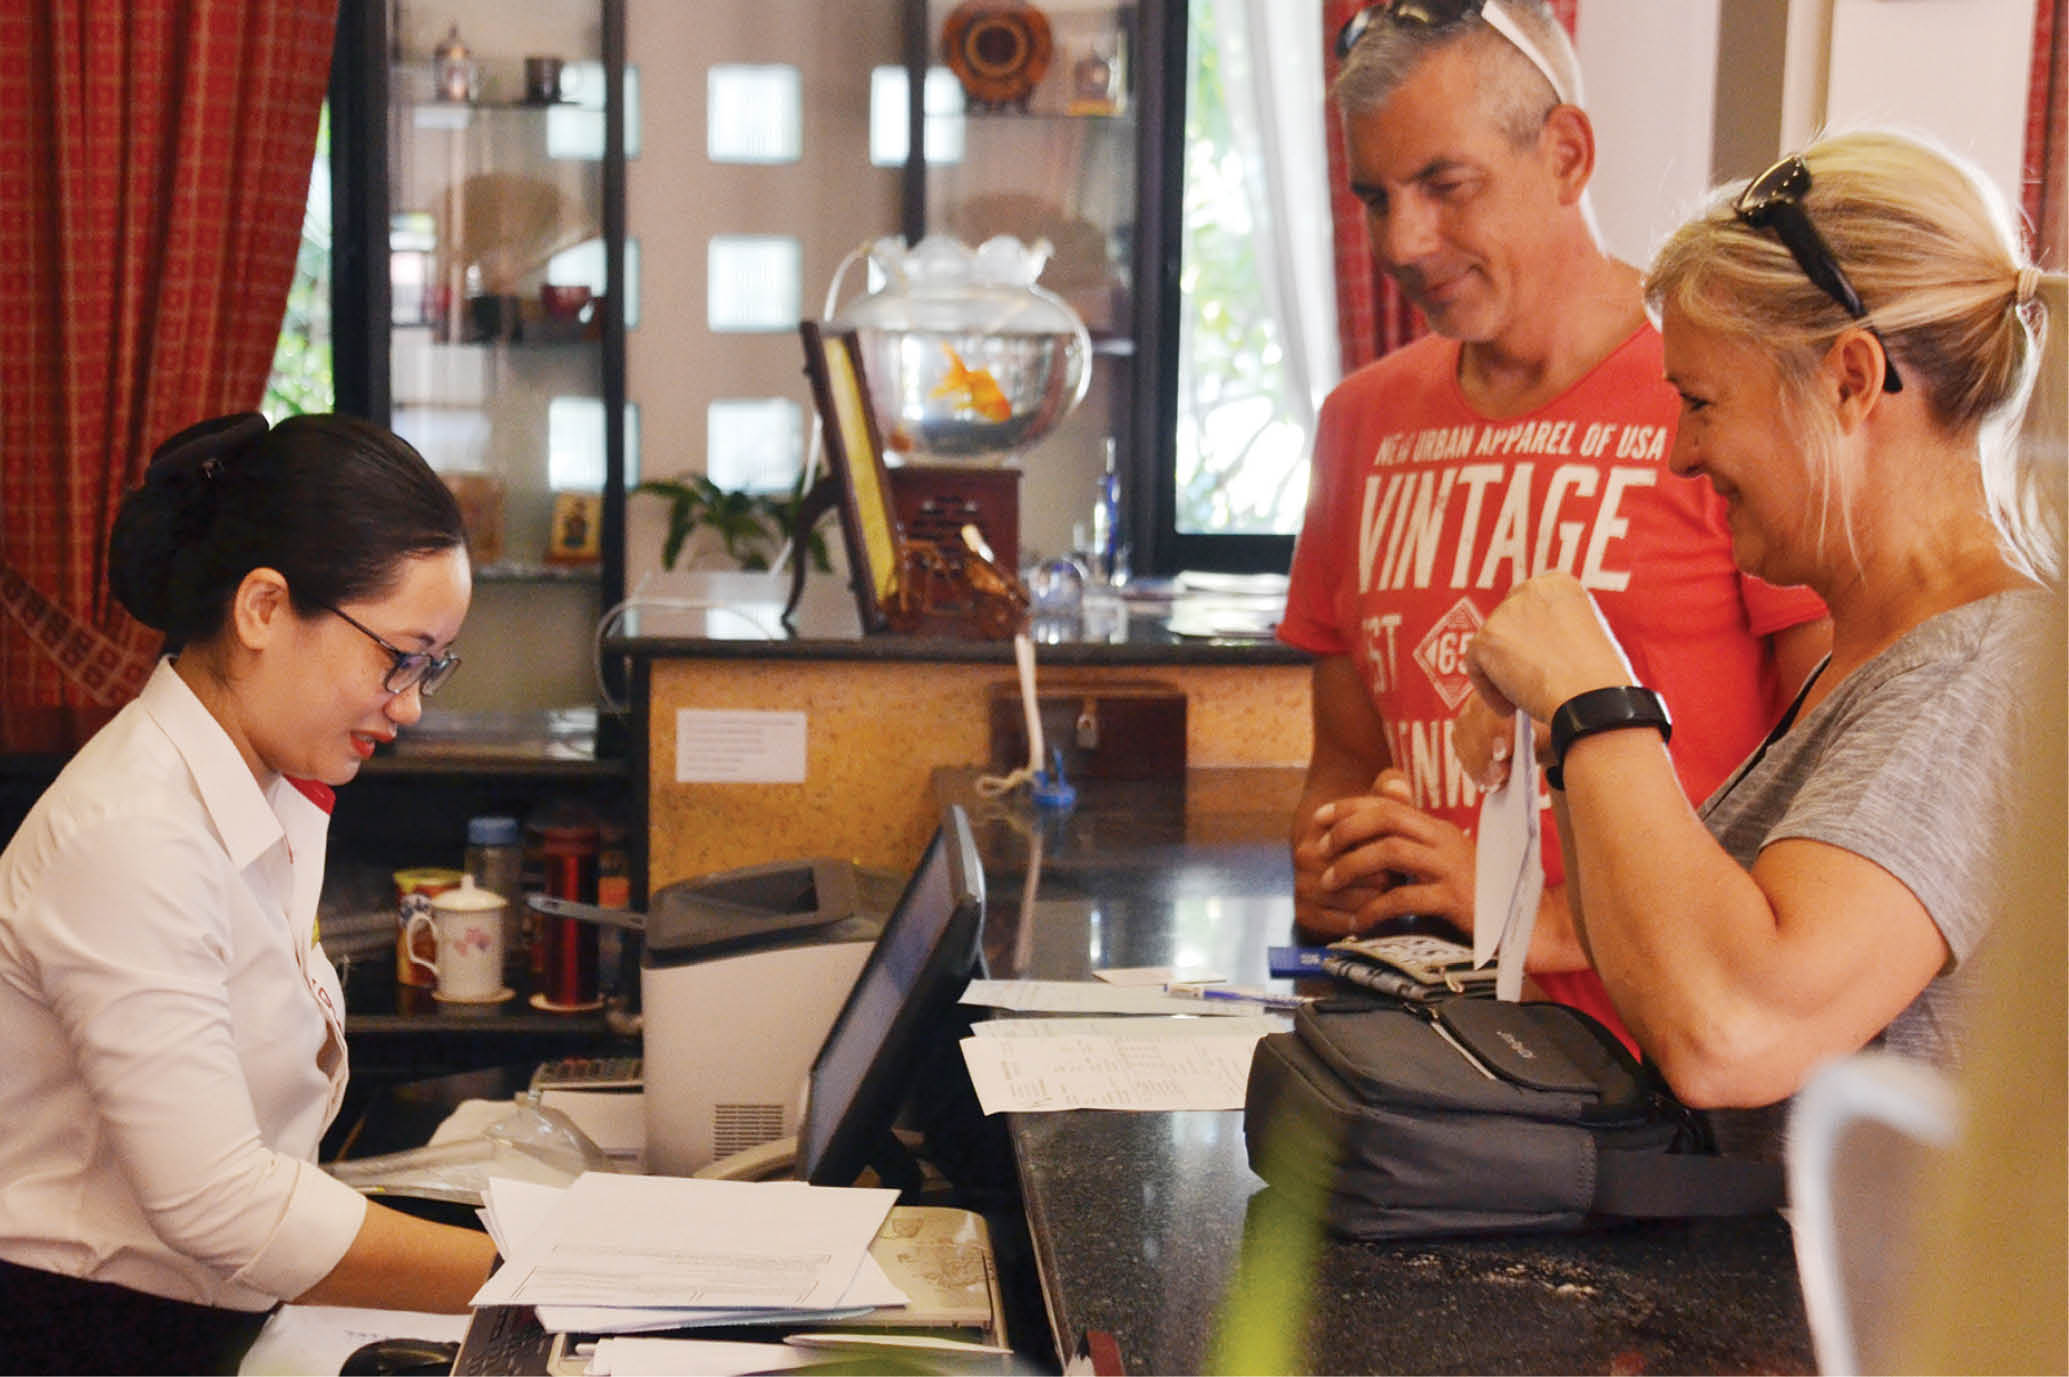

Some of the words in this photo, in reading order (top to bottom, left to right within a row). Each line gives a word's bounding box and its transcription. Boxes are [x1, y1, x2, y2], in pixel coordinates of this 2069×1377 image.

[1413, 425, 1475, 462] URBAN
[1474, 421, 1576, 457] APPAREL
[1579, 422, 1617, 458] OF
[1615, 424, 1667, 461] USA
[1358, 462, 1657, 593] VINTAGE
